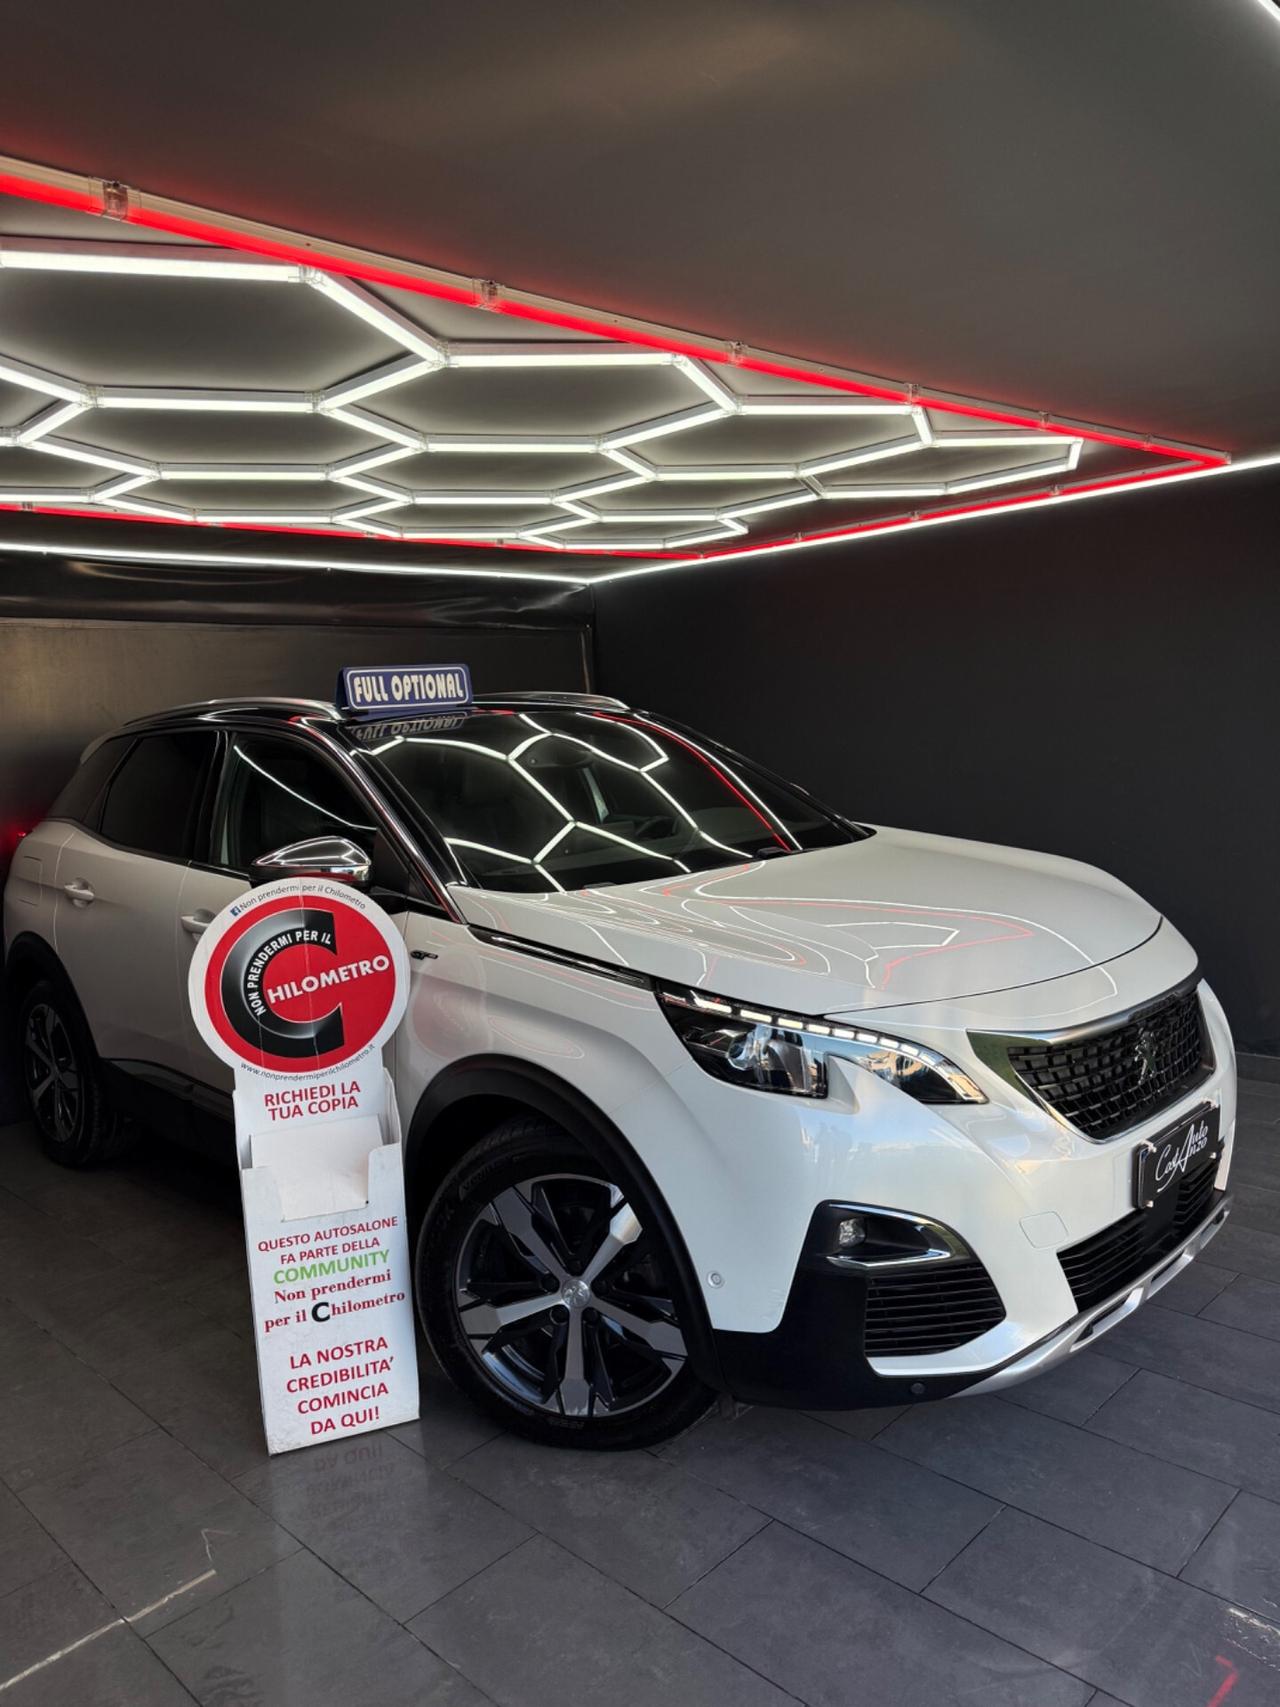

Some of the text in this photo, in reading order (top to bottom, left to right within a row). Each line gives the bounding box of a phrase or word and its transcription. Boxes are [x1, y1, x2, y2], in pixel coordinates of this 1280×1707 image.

[353, 673, 463, 702] FULL OPTIONAL
[240, 884, 366, 911] Non prendermi per il Chilometro
[247, 930, 332, 1016] NON PRENDERMI PER IL
[241, 1043, 376, 1081] www.nonprendermiperilchilometro.it
[264, 1081, 361, 1107] RICHIEDI LA
[269, 1096, 359, 1121] TUA COPIA
[258, 1216, 397, 1251] QUESTO AUTOSALONE
[281, 1237, 380, 1264] FA PARTE DELLA
[274, 1249, 389, 1284] COMMUNITY
[274, 1269, 392, 1304] Non prendermi
[264, 1291, 405, 1332] per il Chilometro
[290, 1337, 388, 1369] LA NOSTRA
[298, 1383, 389, 1414] COMINCIA
[311, 1406, 380, 1434] DA QUI!
